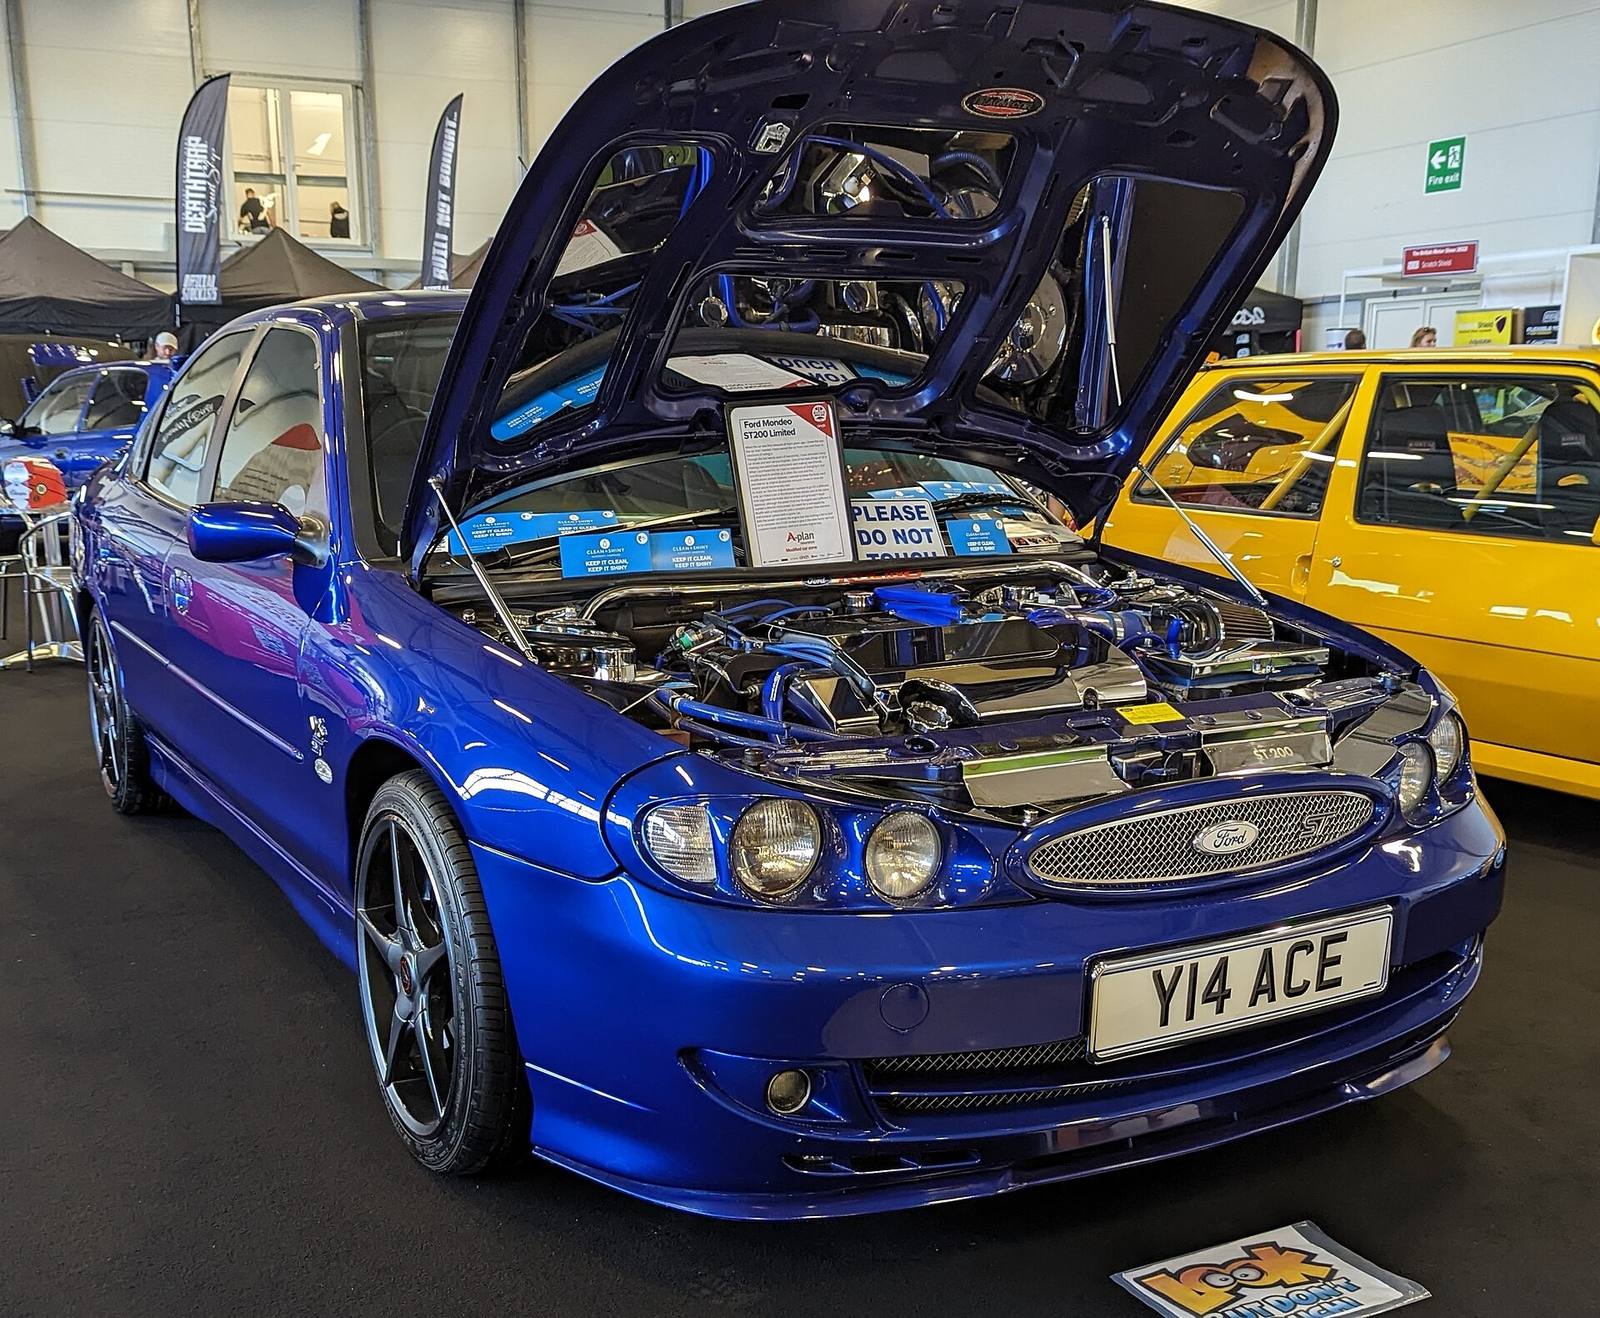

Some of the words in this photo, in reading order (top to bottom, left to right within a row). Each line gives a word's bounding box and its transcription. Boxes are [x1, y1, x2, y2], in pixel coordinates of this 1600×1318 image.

[183, 136, 208, 232] DEATHTRAP
[1428, 175, 1443, 186] Fire
[1444, 173, 1460, 184] exit
[436, 190, 451, 228] NOT
[744, 420, 761, 429] Ford
[762, 418, 793, 428] Mondeo
[743, 431, 768, 440] ST200
[769, 428, 796, 437] Limited
[852, 505, 930, 522] PLEASE
[787, 531, 815, 542] A-plan
[857, 528, 887, 546] DO
[892, 528, 933, 544] NOT
[1269, 746, 1294, 759] 200
[1300, 811, 1336, 838] ST
[1213, 827, 1248, 848] Ford
[1151, 955, 1232, 1028] Y14
[1247, 931, 1349, 1008] ACE
[1262, 1277, 1361, 1313] DON'T
